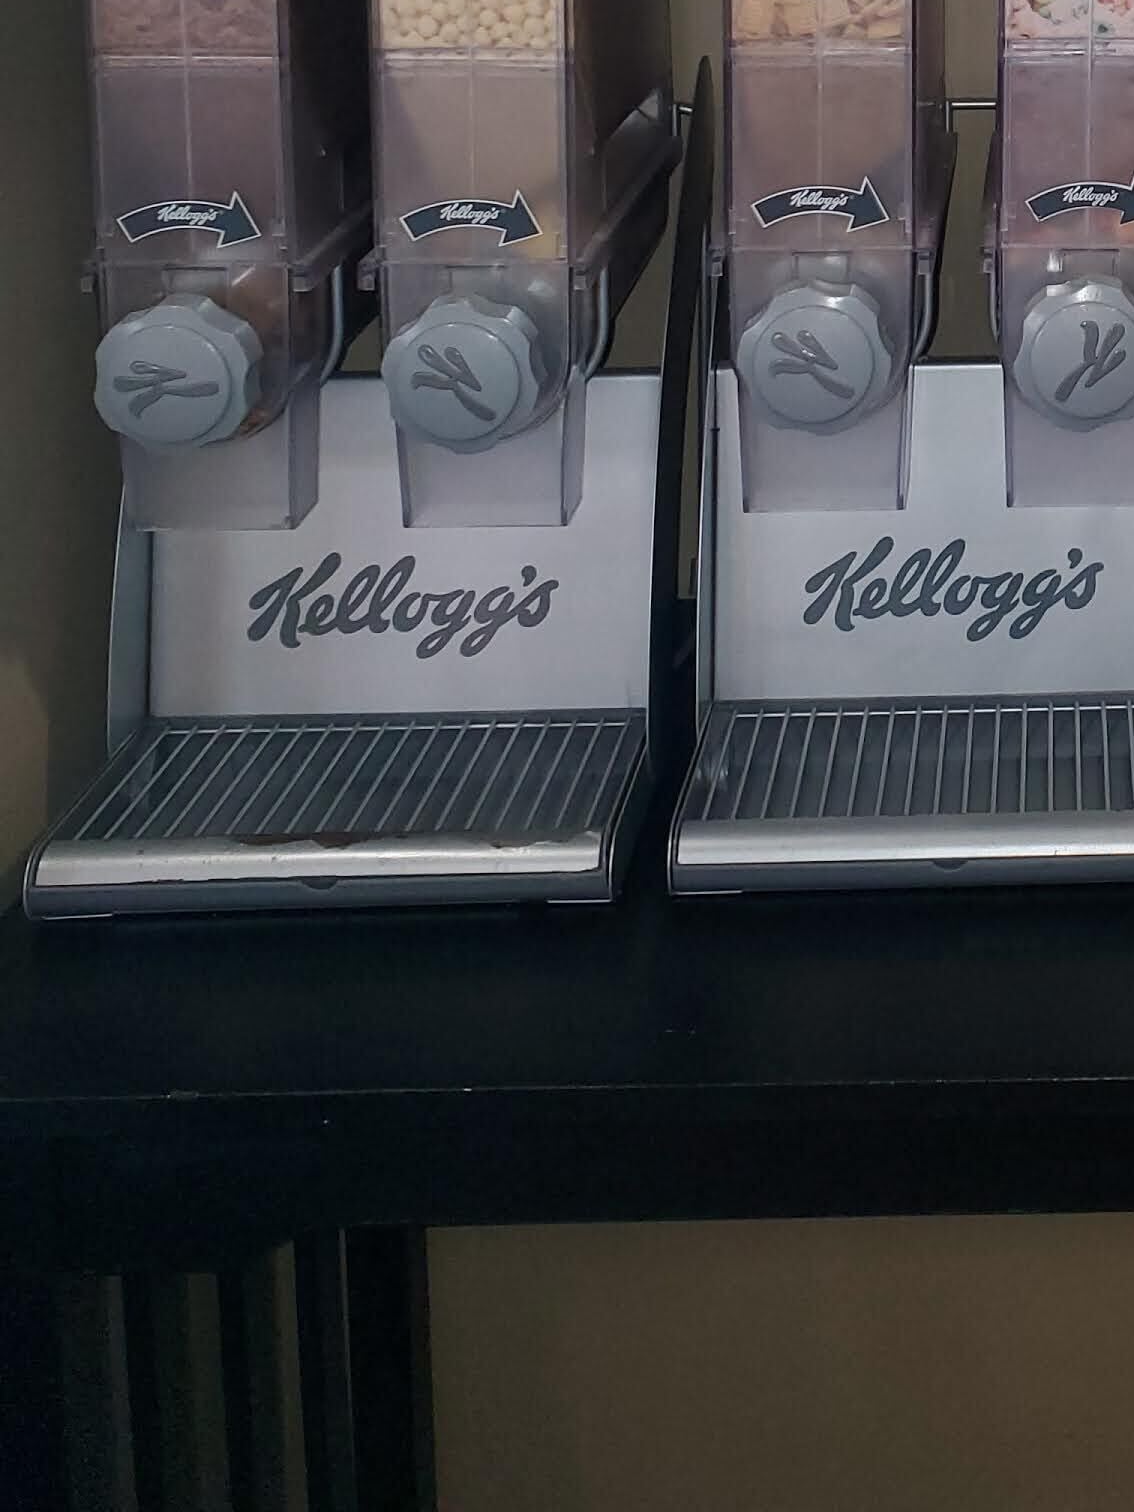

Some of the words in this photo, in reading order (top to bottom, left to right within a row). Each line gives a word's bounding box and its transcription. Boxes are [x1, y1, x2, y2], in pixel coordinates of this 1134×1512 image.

[790, 189, 849, 210] Kellogg's
[1063, 186, 1119, 206] Kellogg's
[157, 204, 218, 225] Kellogg's
[440, 203, 500, 224] Kellogg's
[803, 536, 1103, 642] Kellogg's
[247, 553, 559, 660] Kellogg's
